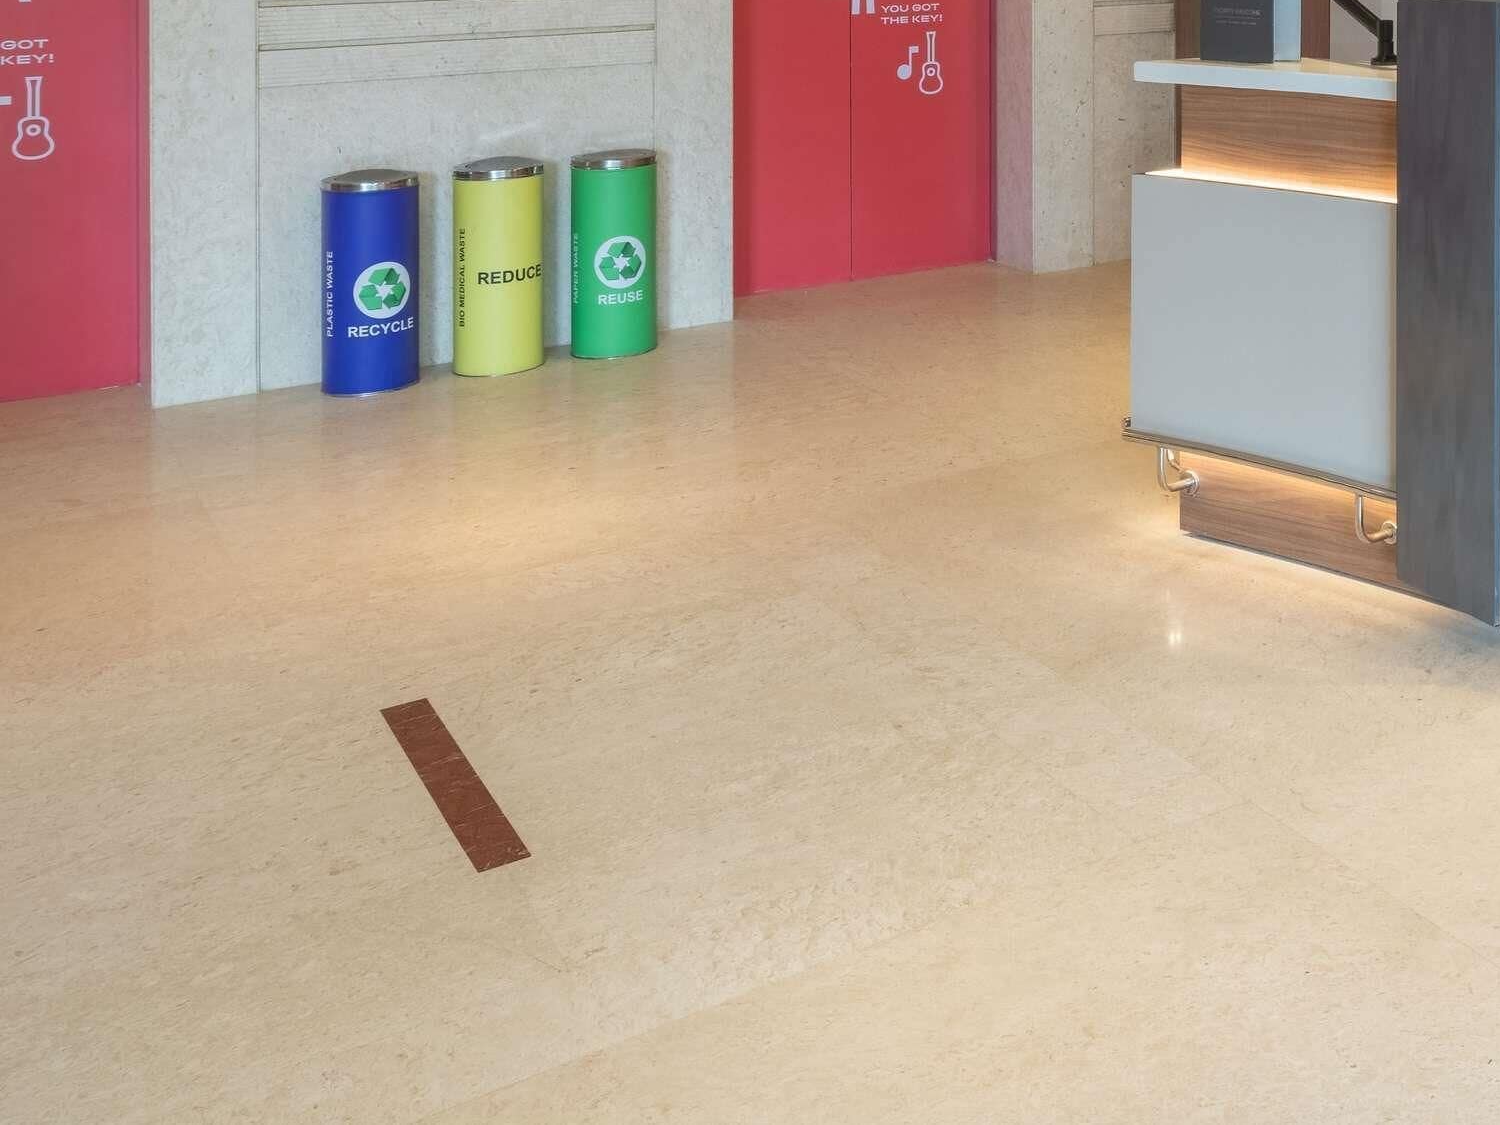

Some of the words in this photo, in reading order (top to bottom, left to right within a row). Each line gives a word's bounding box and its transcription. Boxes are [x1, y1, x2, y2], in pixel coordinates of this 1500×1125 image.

[881, 4, 909, 13] YOU
[912, 3, 940, 12] GOT
[881, 16, 909, 25] THE
[912, 14, 943, 24] KEY!
[0, 39, 49, 50] GOT
[0, 53, 54, 65] KEY!
[477, 263, 542, 285] REDUCE
[598, 290, 643, 305] REUSE
[347, 316, 414, 338] RECYCLE
